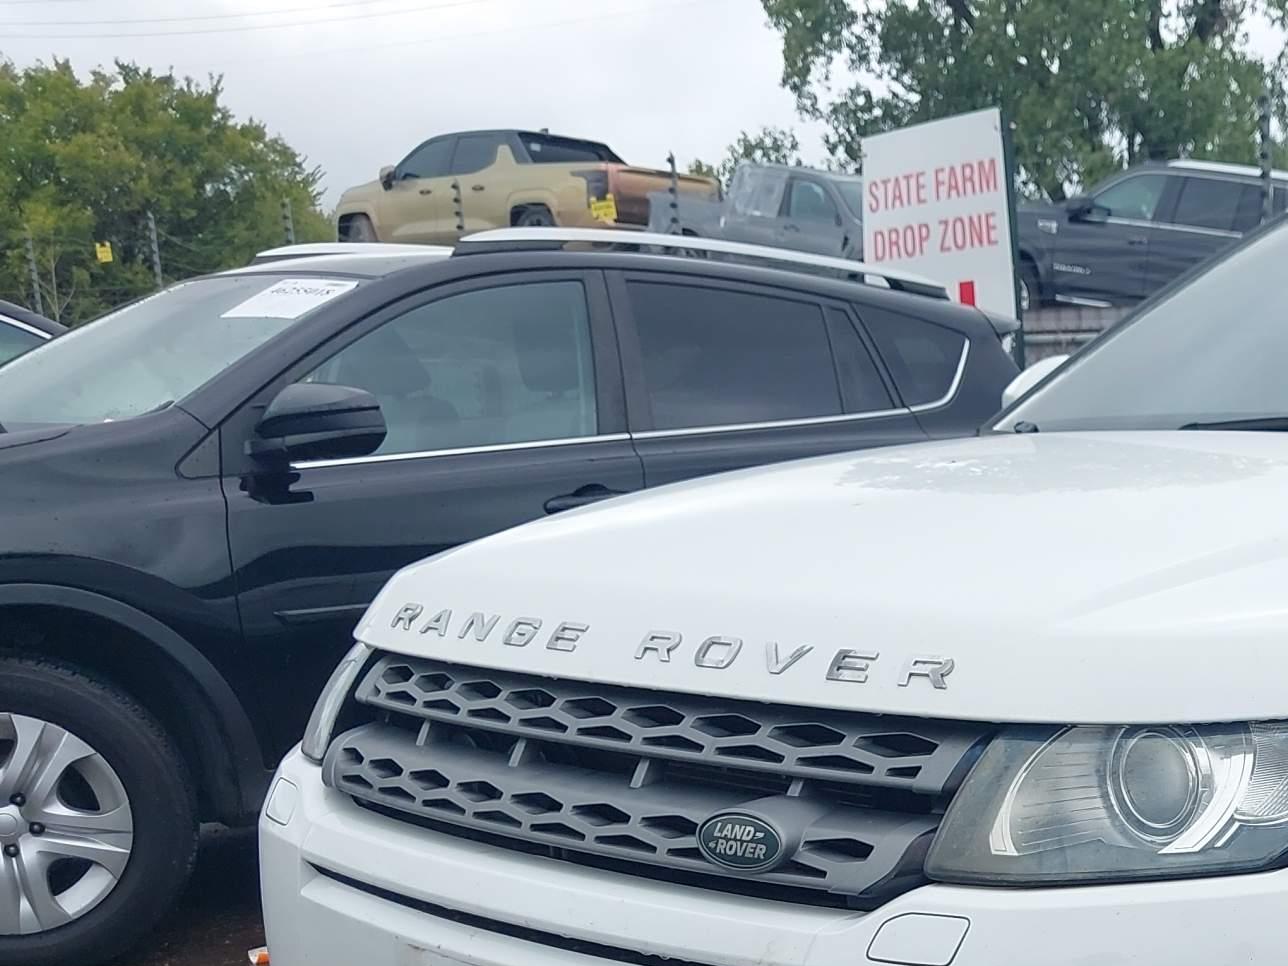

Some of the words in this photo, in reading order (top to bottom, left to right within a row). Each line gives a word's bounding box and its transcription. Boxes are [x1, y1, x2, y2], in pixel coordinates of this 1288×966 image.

[868, 172, 927, 213] STATE
[934, 158, 998, 201] FARM
[874, 223, 930, 262] DROP
[938, 212, 998, 253] ZONE
[389, 602, 590, 653] RANGE
[634, 630, 956, 690] ROVER
[713, 822, 756, 841] LAND
[716, 839, 767, 860] ROVER
